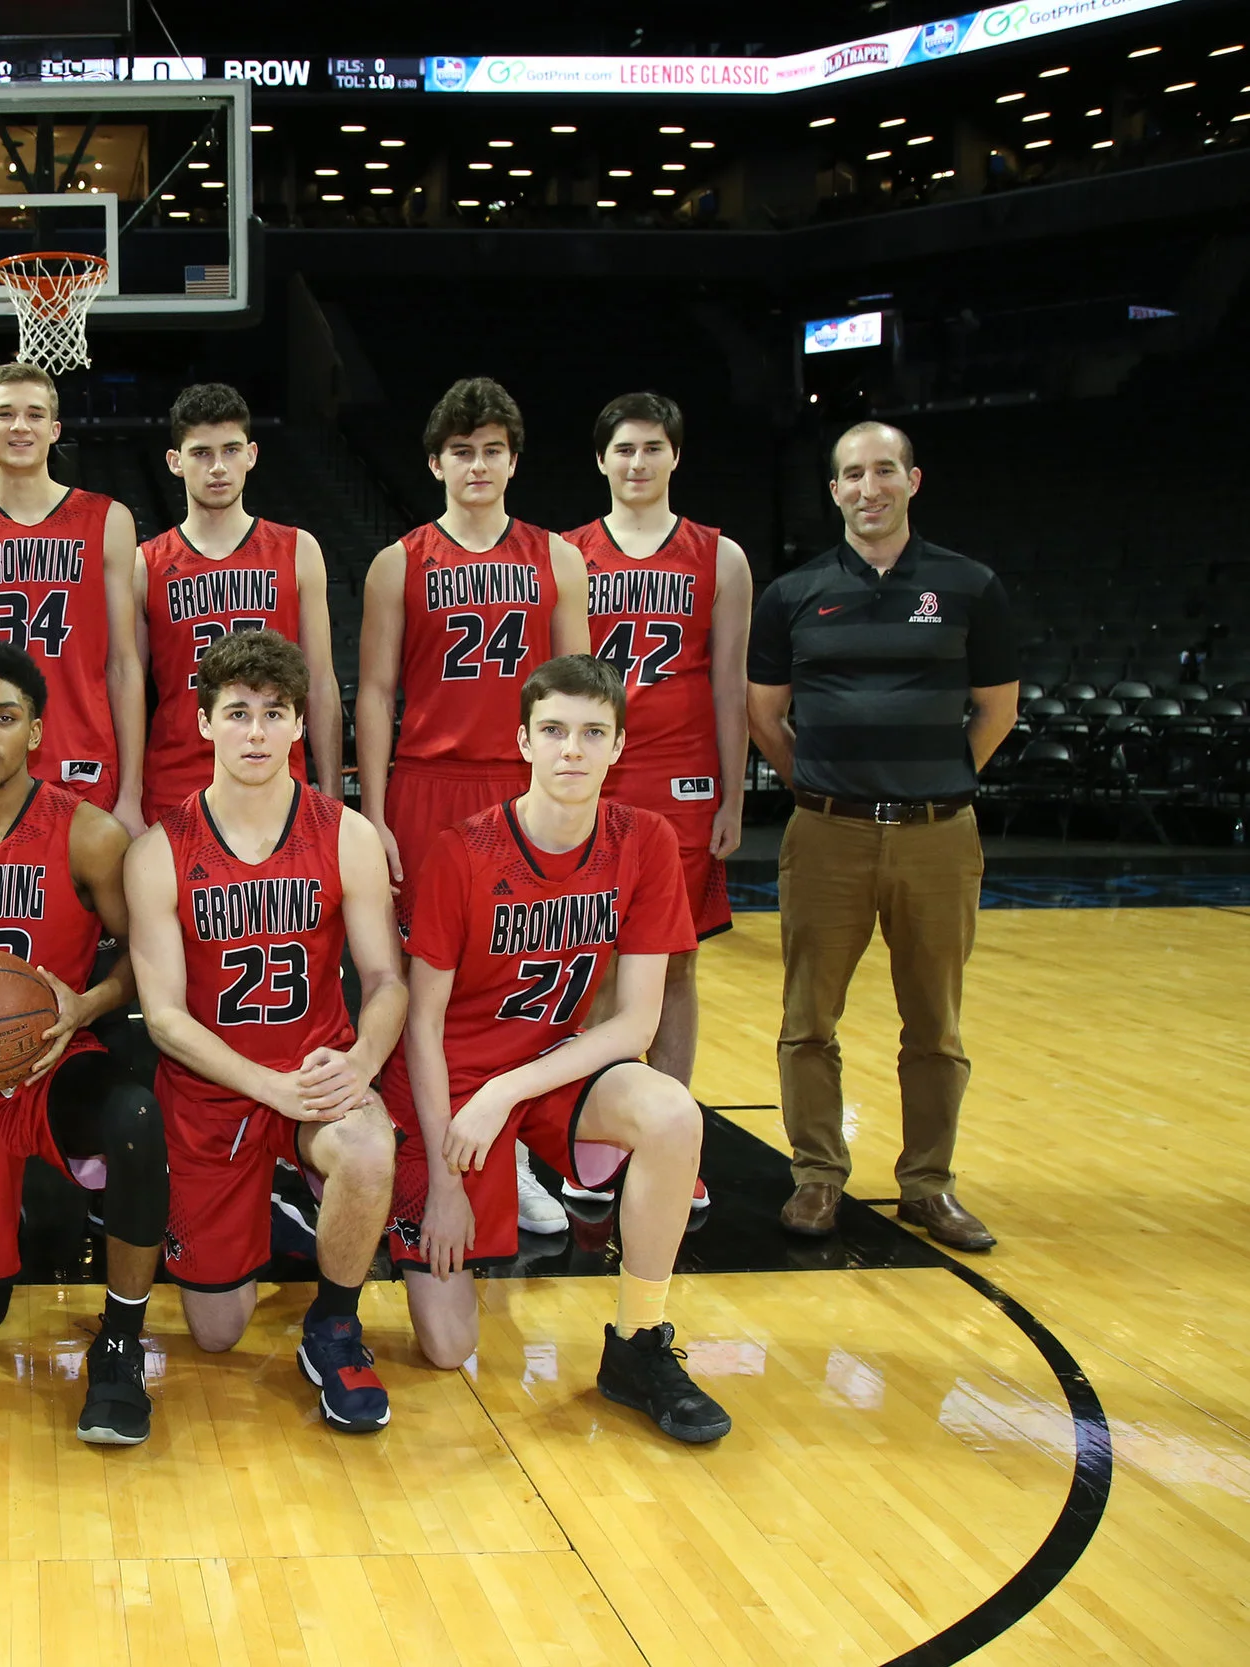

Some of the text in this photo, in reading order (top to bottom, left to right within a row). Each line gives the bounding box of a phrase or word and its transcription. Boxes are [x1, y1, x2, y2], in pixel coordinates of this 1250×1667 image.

[224, 60, 310, 87] BROW
[336, 58, 386, 74] FLS: 0
[336, 76, 365, 89] TOL:
[620, 64, 695, 84] LEGENDS
[700, 65, 769, 85] CLASSIC
[167, 569, 278, 623] BROWNING
[426, 562, 540, 612] BROWNING
[587, 569, 696, 617] BROWNING
[913, 591, 939, 616] B
[908, 615, 943, 623] ATHLETICS
[441, 610, 530, 681] 24
[594, 621, 684, 687] 42
[192, 877, 322, 941] BROWNING
[216, 941, 310, 1026] 23
[495, 953, 598, 1025] 21
